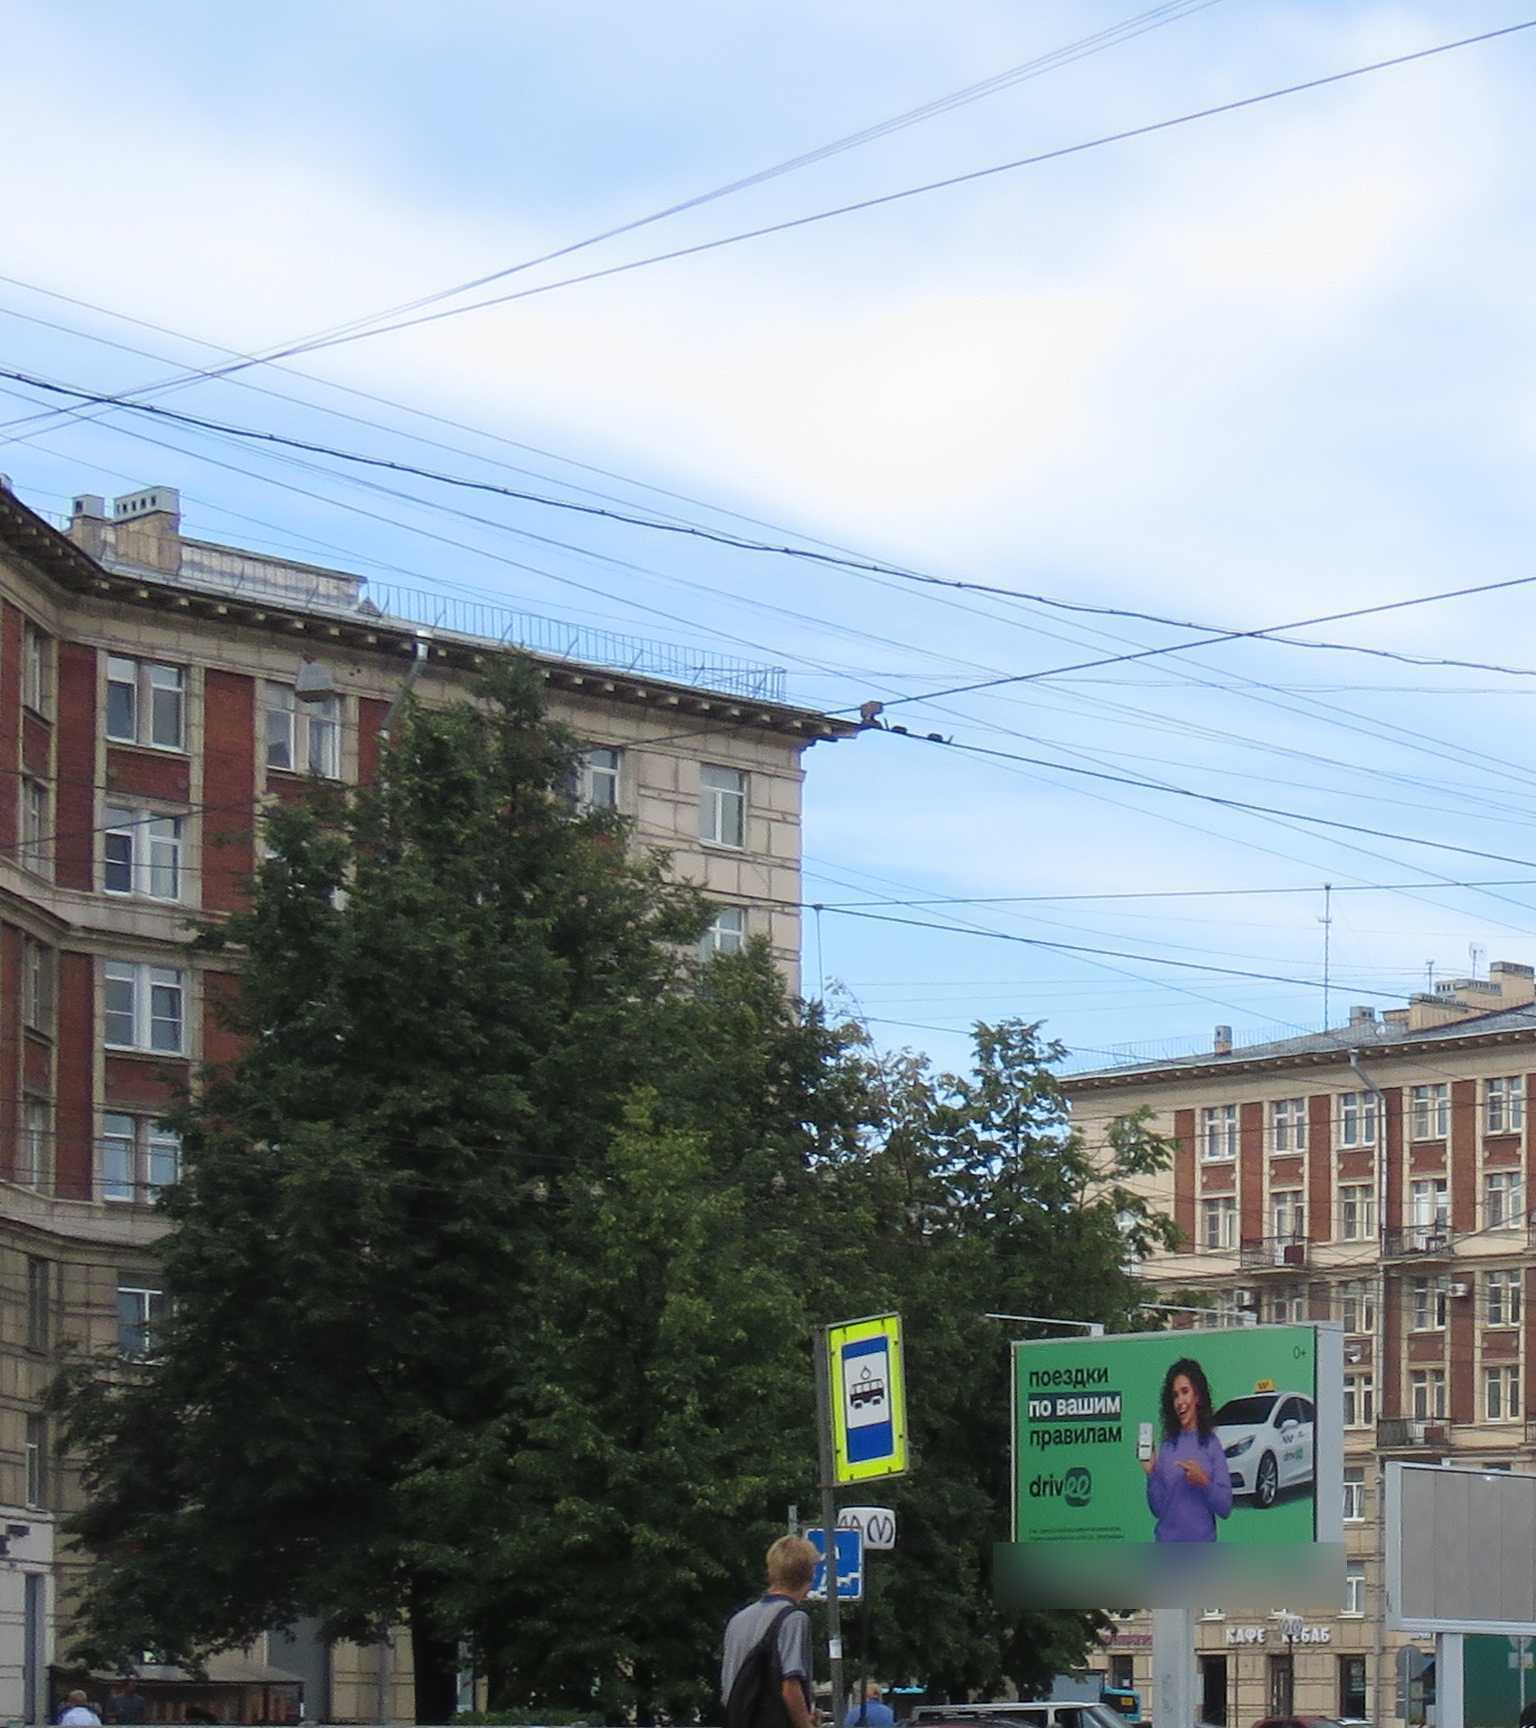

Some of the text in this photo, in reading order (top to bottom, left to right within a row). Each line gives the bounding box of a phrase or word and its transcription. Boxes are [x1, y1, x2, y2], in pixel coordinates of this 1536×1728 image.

[1028, 1366, 1109, 1389] поездки
[1028, 1395, 1121, 1418] по вашим
[1029, 1425, 1122, 1451] правилам
[1225, 1627, 1266, 1645] КАФЕ
